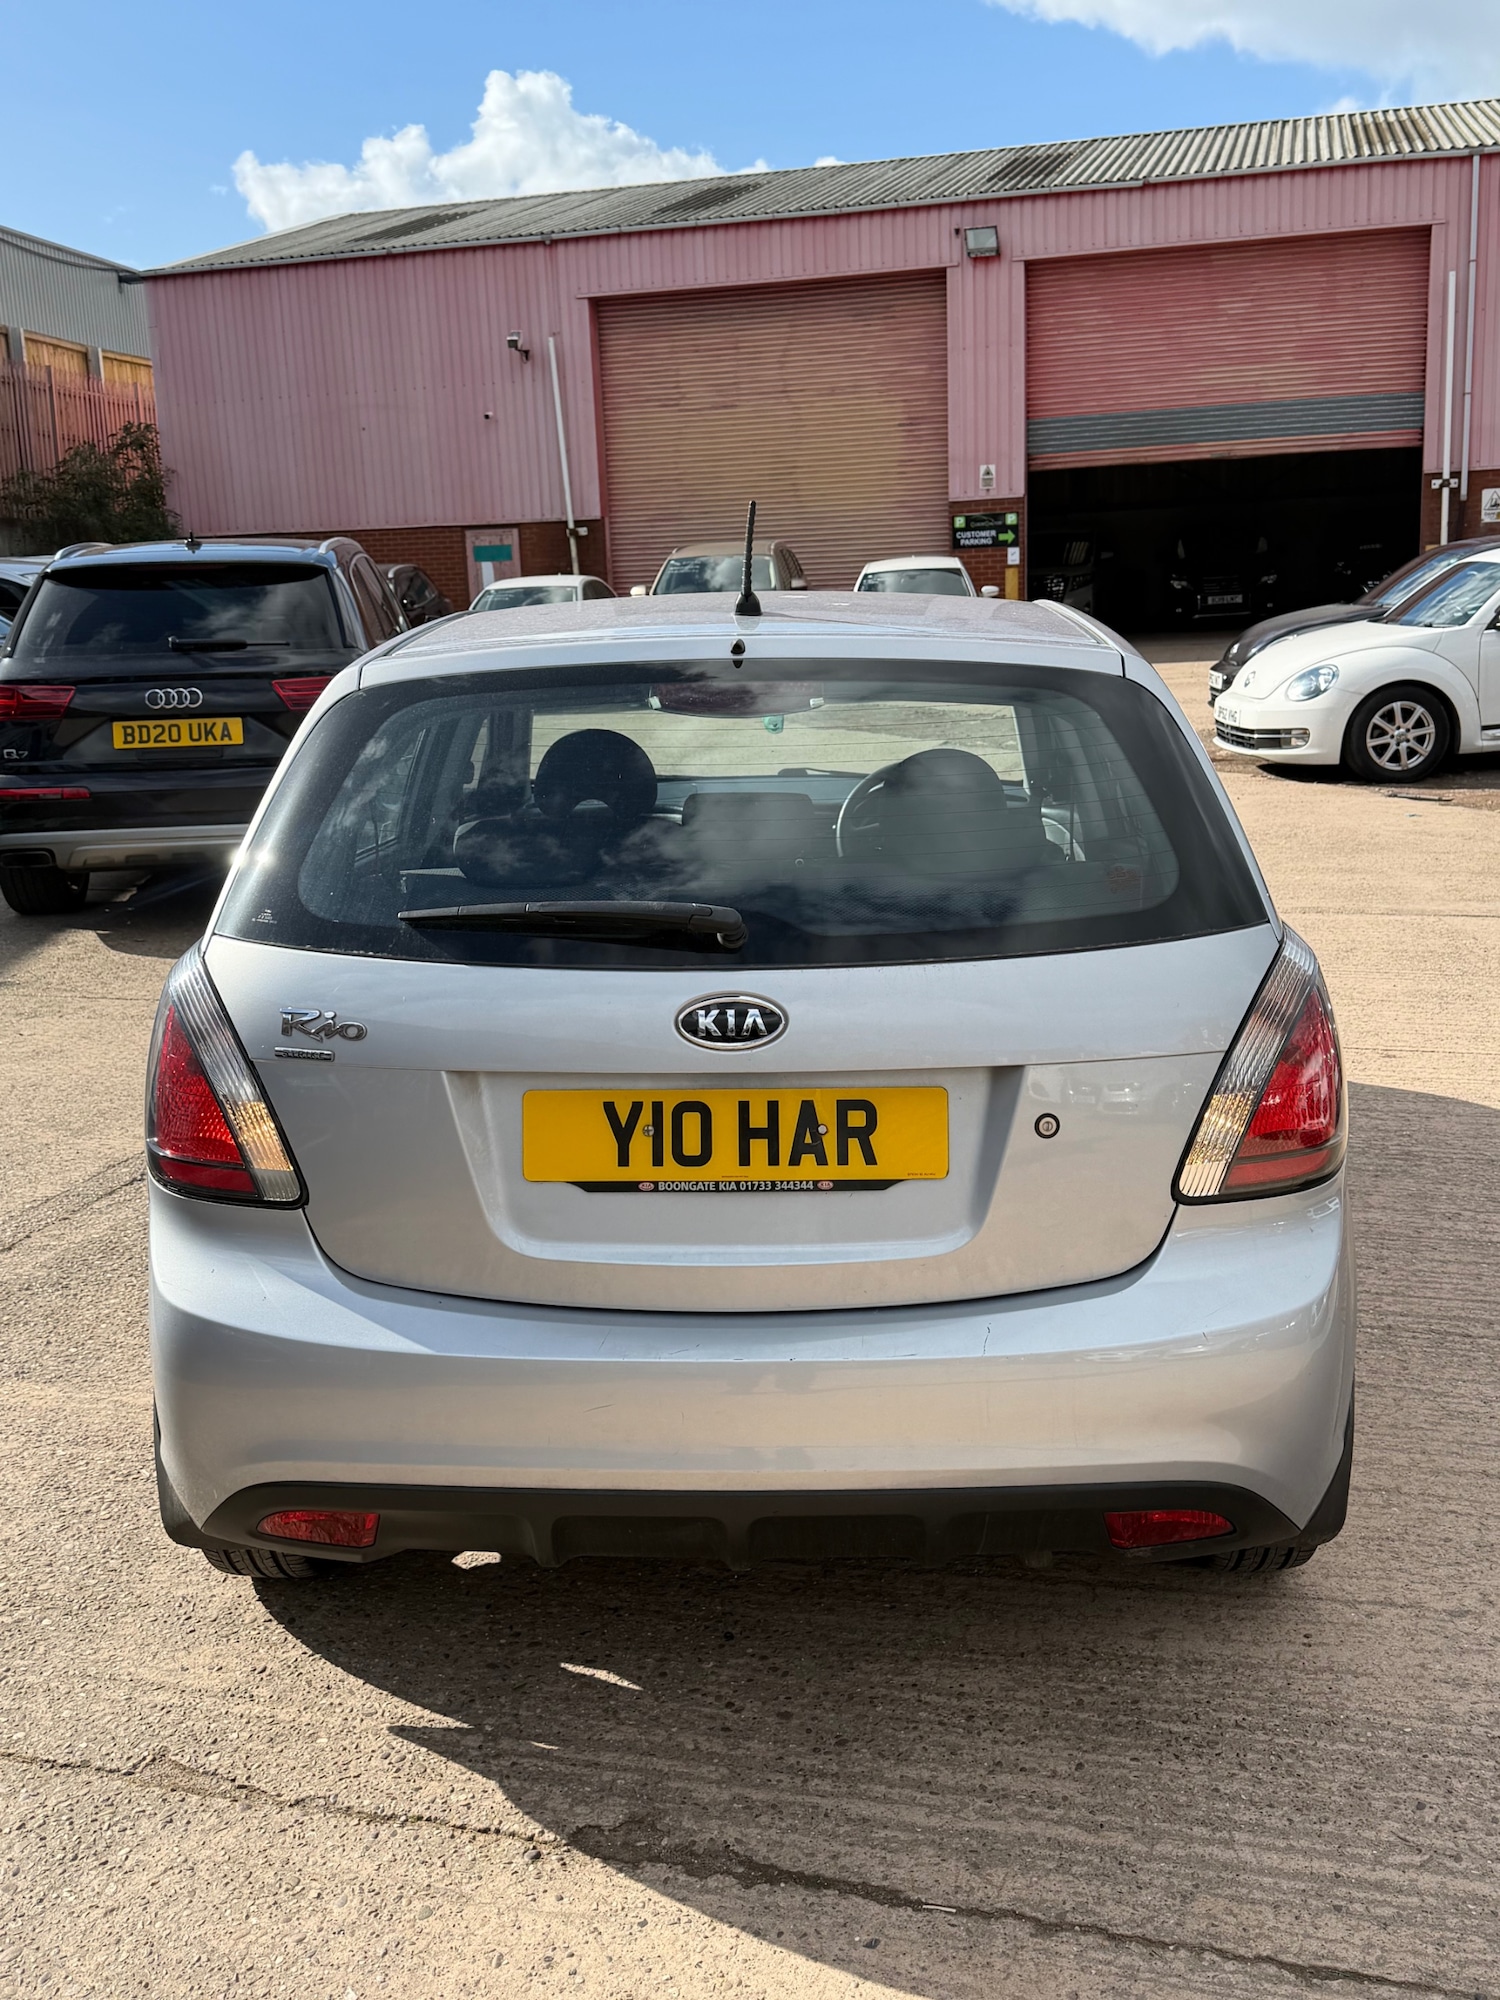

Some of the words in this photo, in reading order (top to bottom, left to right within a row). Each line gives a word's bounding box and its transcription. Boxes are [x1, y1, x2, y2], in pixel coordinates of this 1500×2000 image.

[955, 530, 996, 539] CUSTOMER
[960, 538, 992, 546] PARKING
[122, 723, 181, 745] BD20
[188, 721, 233, 742] UKA
[3, 748, 28, 759] Q7
[280, 1006, 367, 1043] Rio
[696, 1008, 768, 1037] KIA
[737, 1098, 878, 1167] HAR
[658, 1181, 716, 1191] BOONGATE
[718, 1181, 737, 1191] KIA
[739, 1181, 772, 1190] 01733
[774, 1180, 814, 1190] 344344
